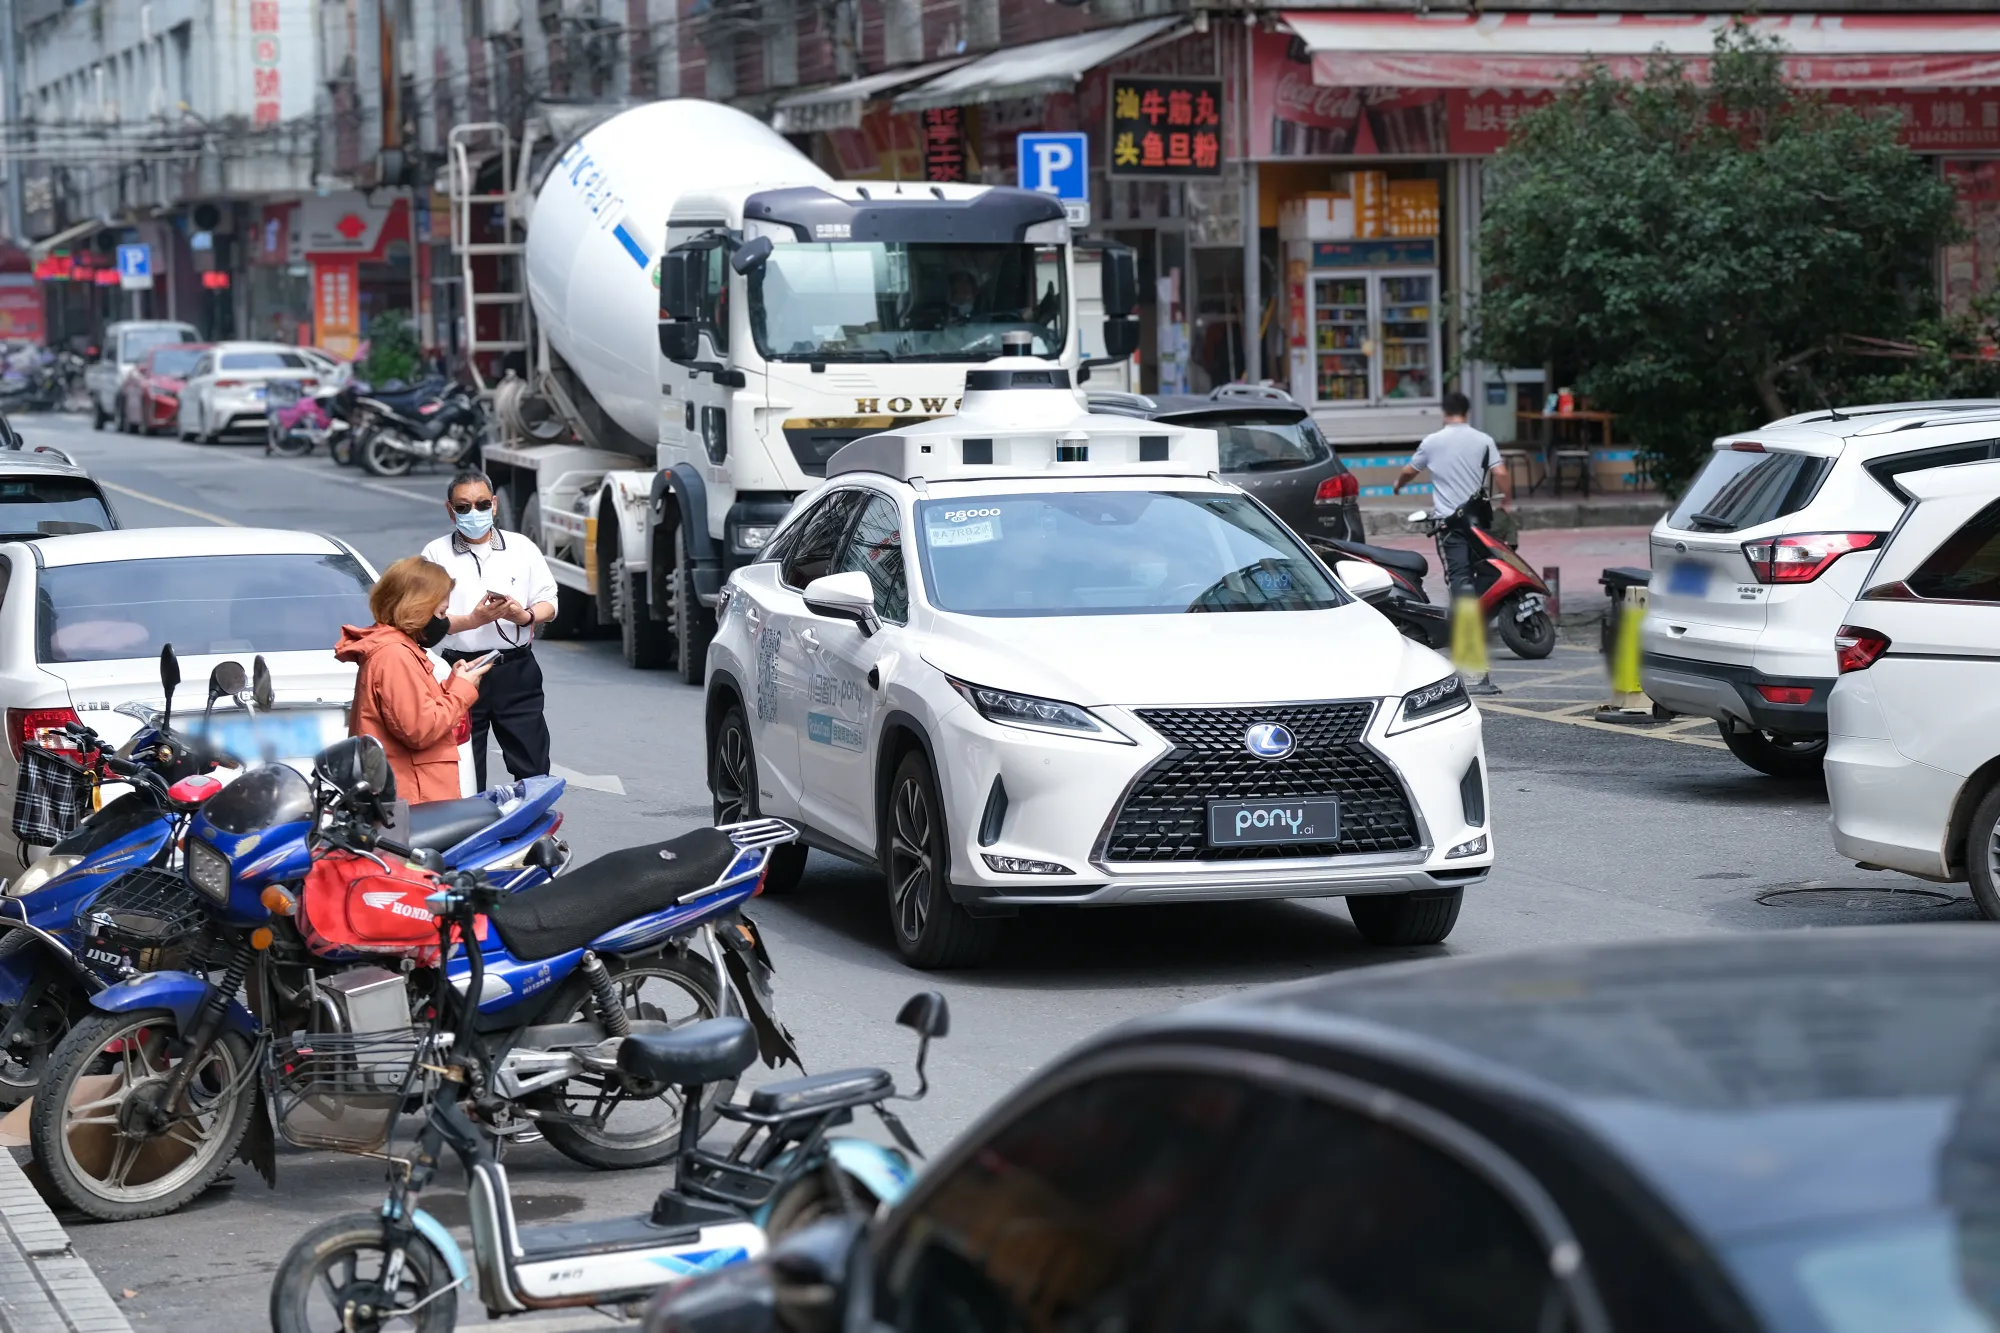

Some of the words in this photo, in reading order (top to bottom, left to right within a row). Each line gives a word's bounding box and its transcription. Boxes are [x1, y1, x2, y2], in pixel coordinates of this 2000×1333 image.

[1141, 89, 1219, 127] 牛筋丸
[1140, 131, 1219, 168] 鱼旦粉
[1033, 143, 1073, 194] P
[127, 248, 145, 275] P
[855, 397, 962, 413] HOW
[944, 508, 1001, 520] P6000
